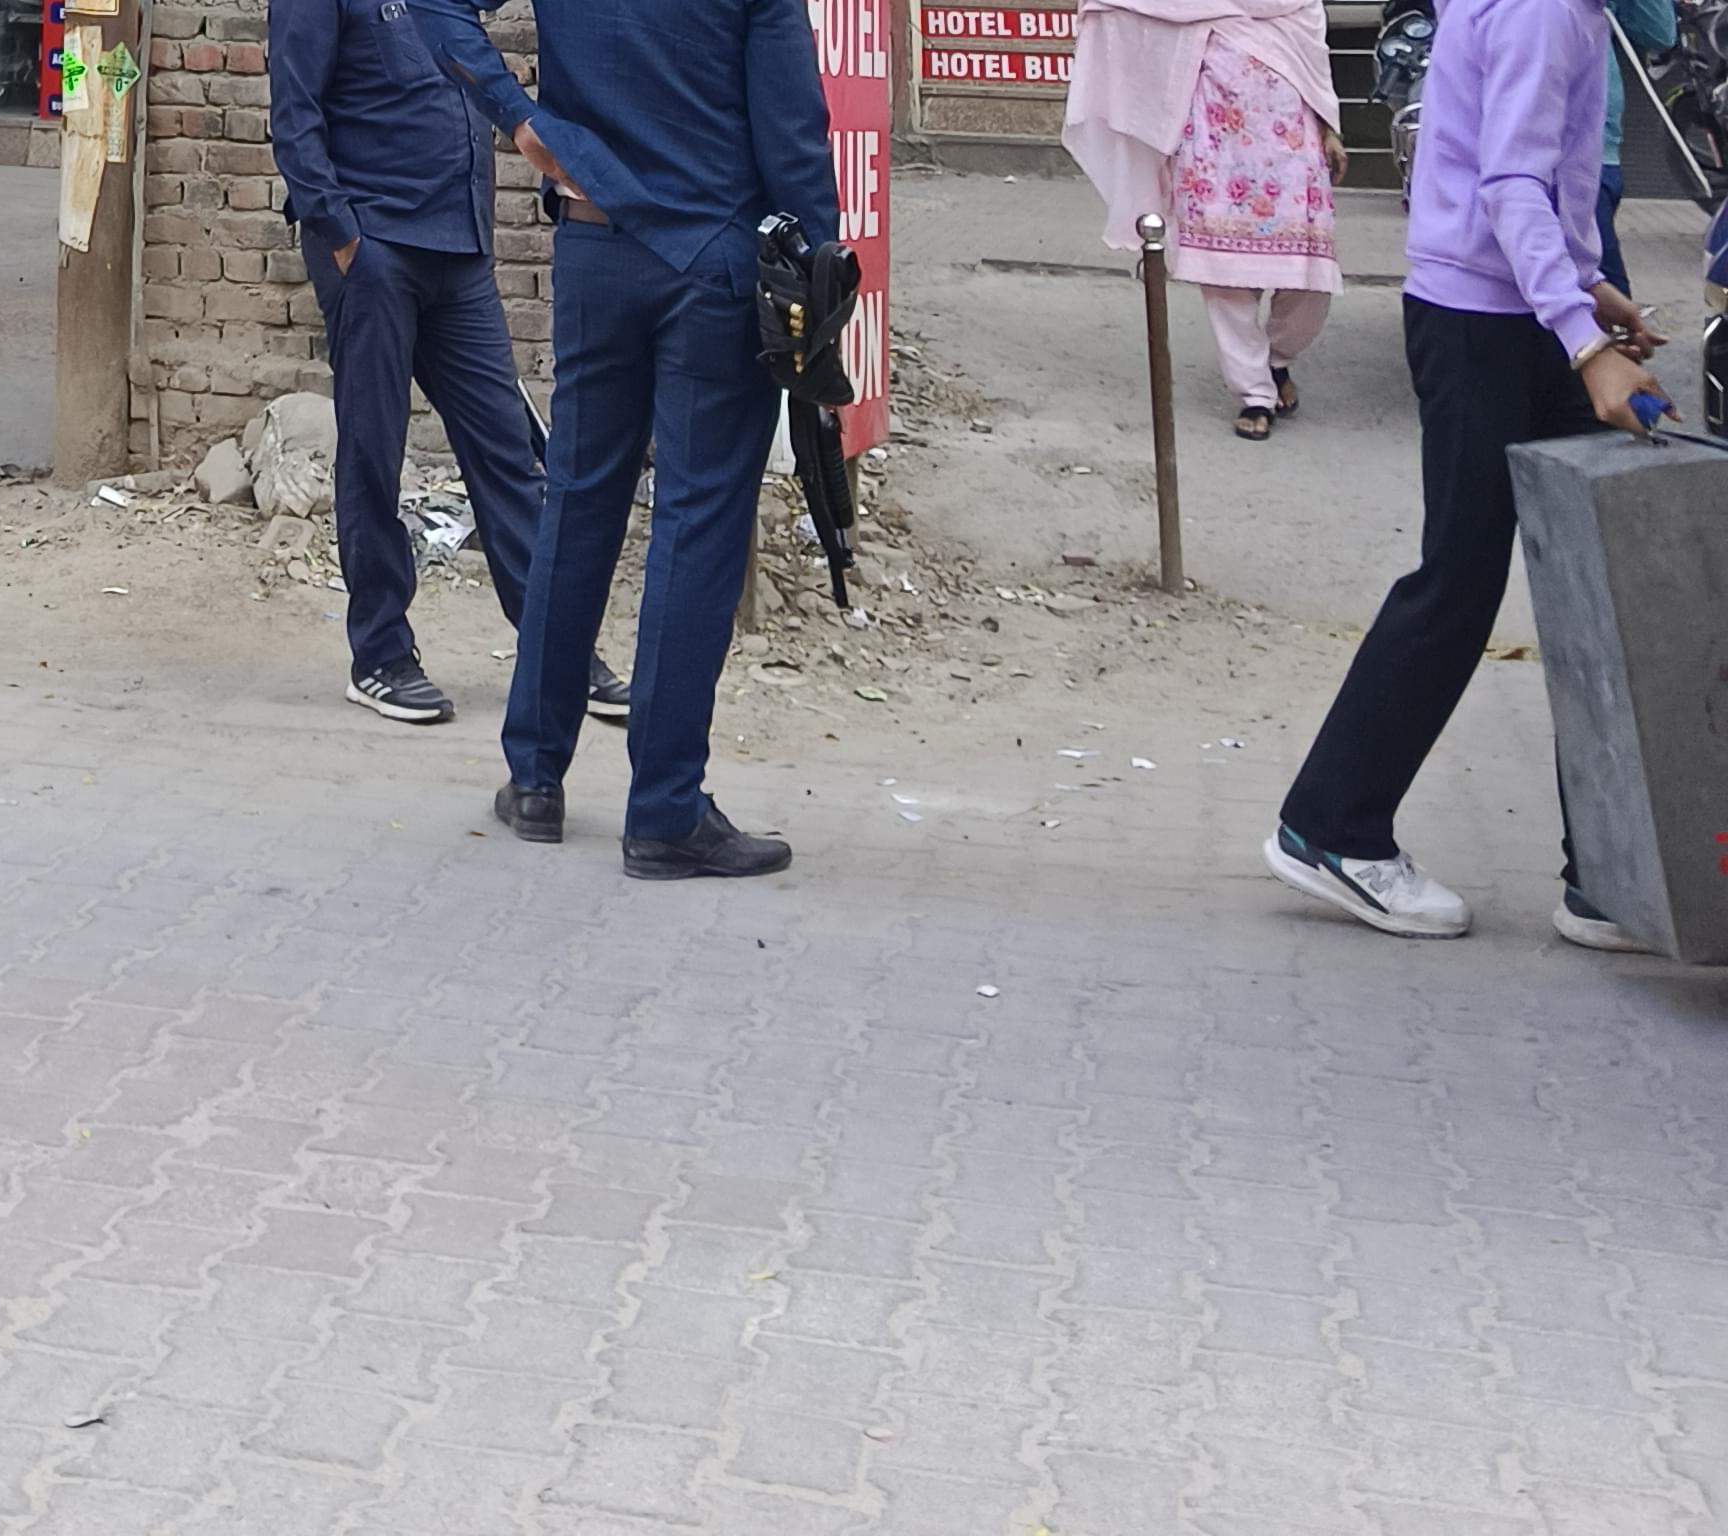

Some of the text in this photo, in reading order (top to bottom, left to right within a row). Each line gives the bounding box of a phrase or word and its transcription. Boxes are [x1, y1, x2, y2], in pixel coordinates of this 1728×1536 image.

[927, 10, 1012, 37] HOTEL
[931, 51, 1017, 80] HOTEL
[830, 130, 880, 242] LUE
